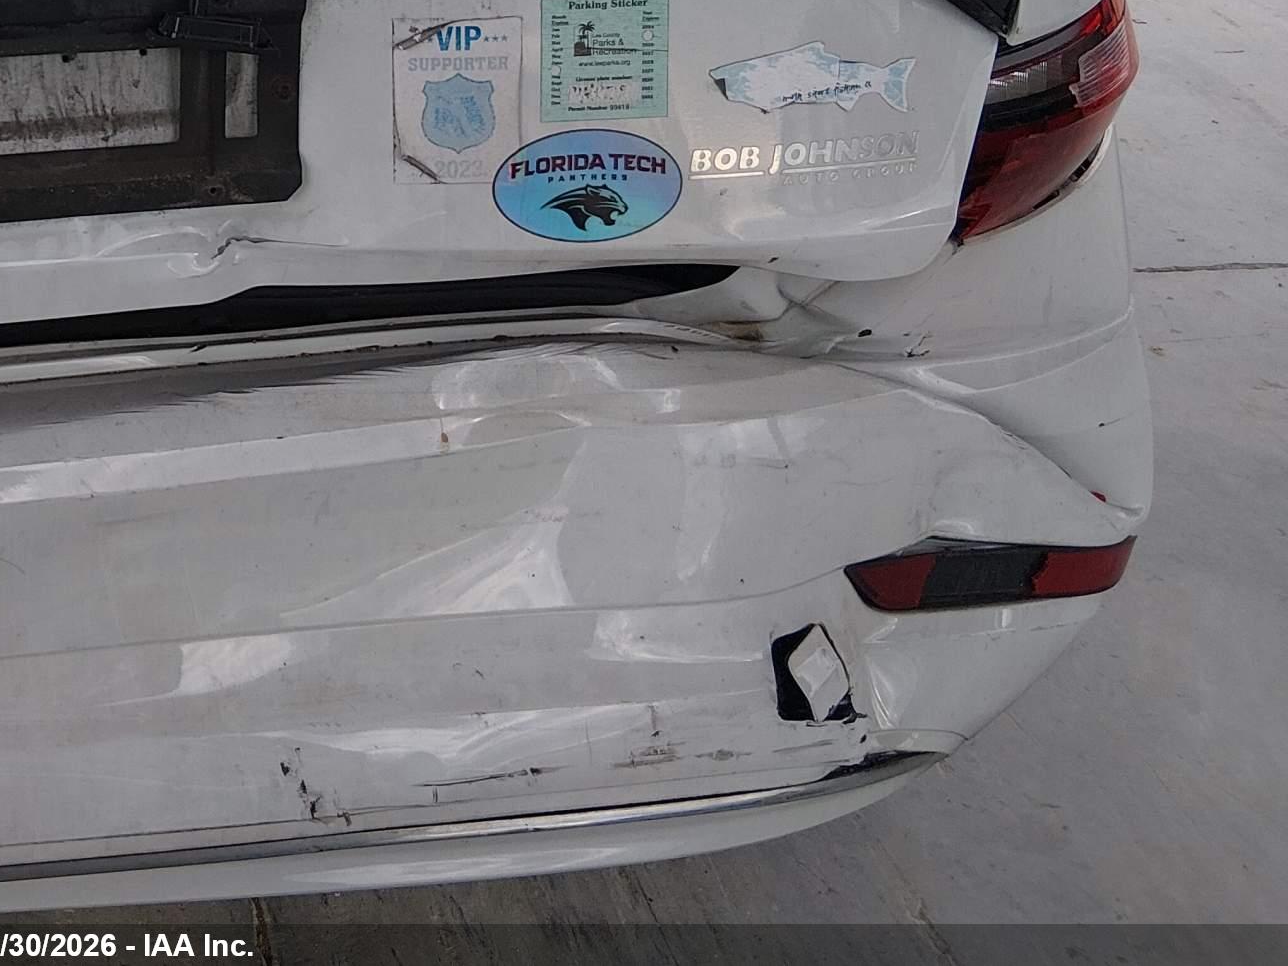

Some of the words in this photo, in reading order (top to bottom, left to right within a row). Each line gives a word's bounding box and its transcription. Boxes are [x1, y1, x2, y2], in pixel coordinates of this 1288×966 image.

[568, 0, 607, 10] Parking
[610, 0, 648, 8] Sticker
[436, 25, 482, 51] VIP
[592, 38, 616, 46] Parks
[618, 38, 624, 46] &
[407, 56, 509, 71] SUPPORTER
[689, 146, 760, 172] BOB
[769, 132, 919, 174] JOHNSON
[510, 153, 606, 179] FLORIDA
[609, 153, 666, 174] TECH
[548, 174, 628, 183] PANTHERS
[783, 171, 840, 185] AUTO
